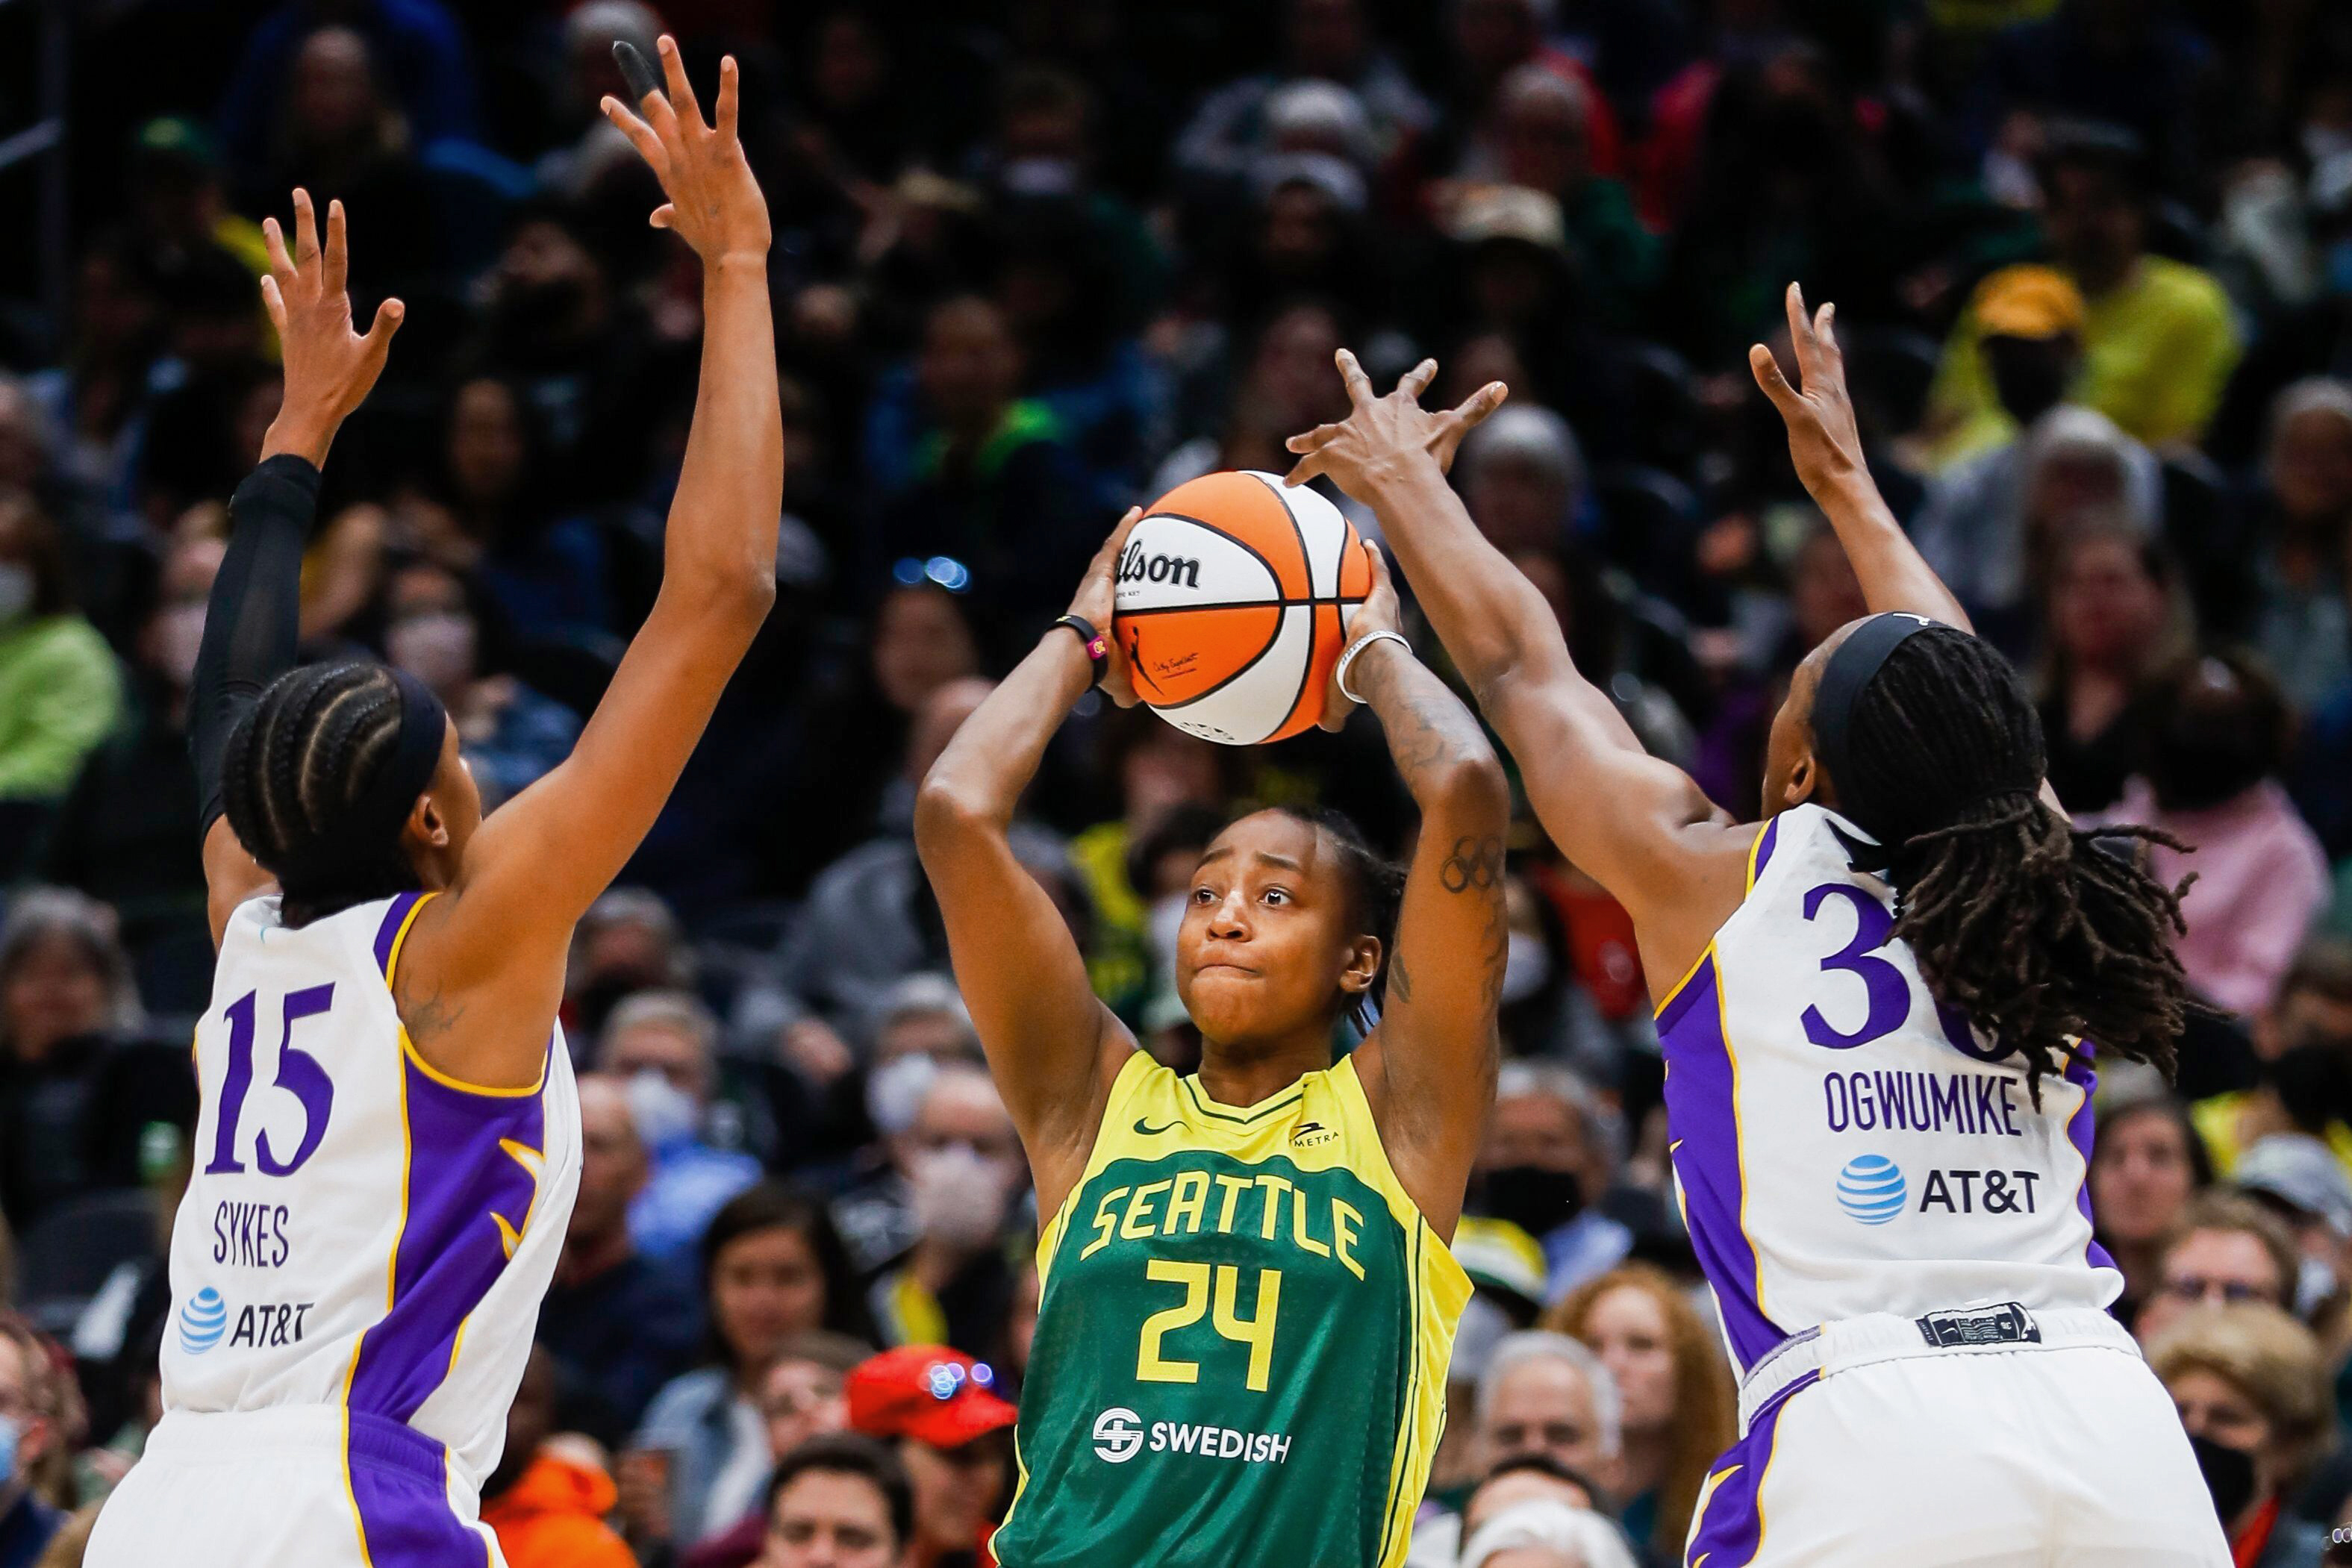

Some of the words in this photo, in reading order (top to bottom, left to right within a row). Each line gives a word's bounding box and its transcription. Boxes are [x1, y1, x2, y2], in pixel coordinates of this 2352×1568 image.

[1117, 540, 1199, 589] ilson
[1800, 882, 2020, 1063] 3
[205, 981, 336, 1177] 15
[1824, 1071, 2023, 1137] OGWUMIKE
[1294, 1131, 1339, 1146] METRA
[1919, 1169, 2039, 1214] AT&T
[213, 1200, 290, 1268] SYKES
[1079, 1169, 1366, 1282] SEATTLE
[229, 1302, 314, 1348] AT&T
[1135, 1258, 1282, 1393] 24
[1149, 1421, 1292, 1464] SWEDISH
